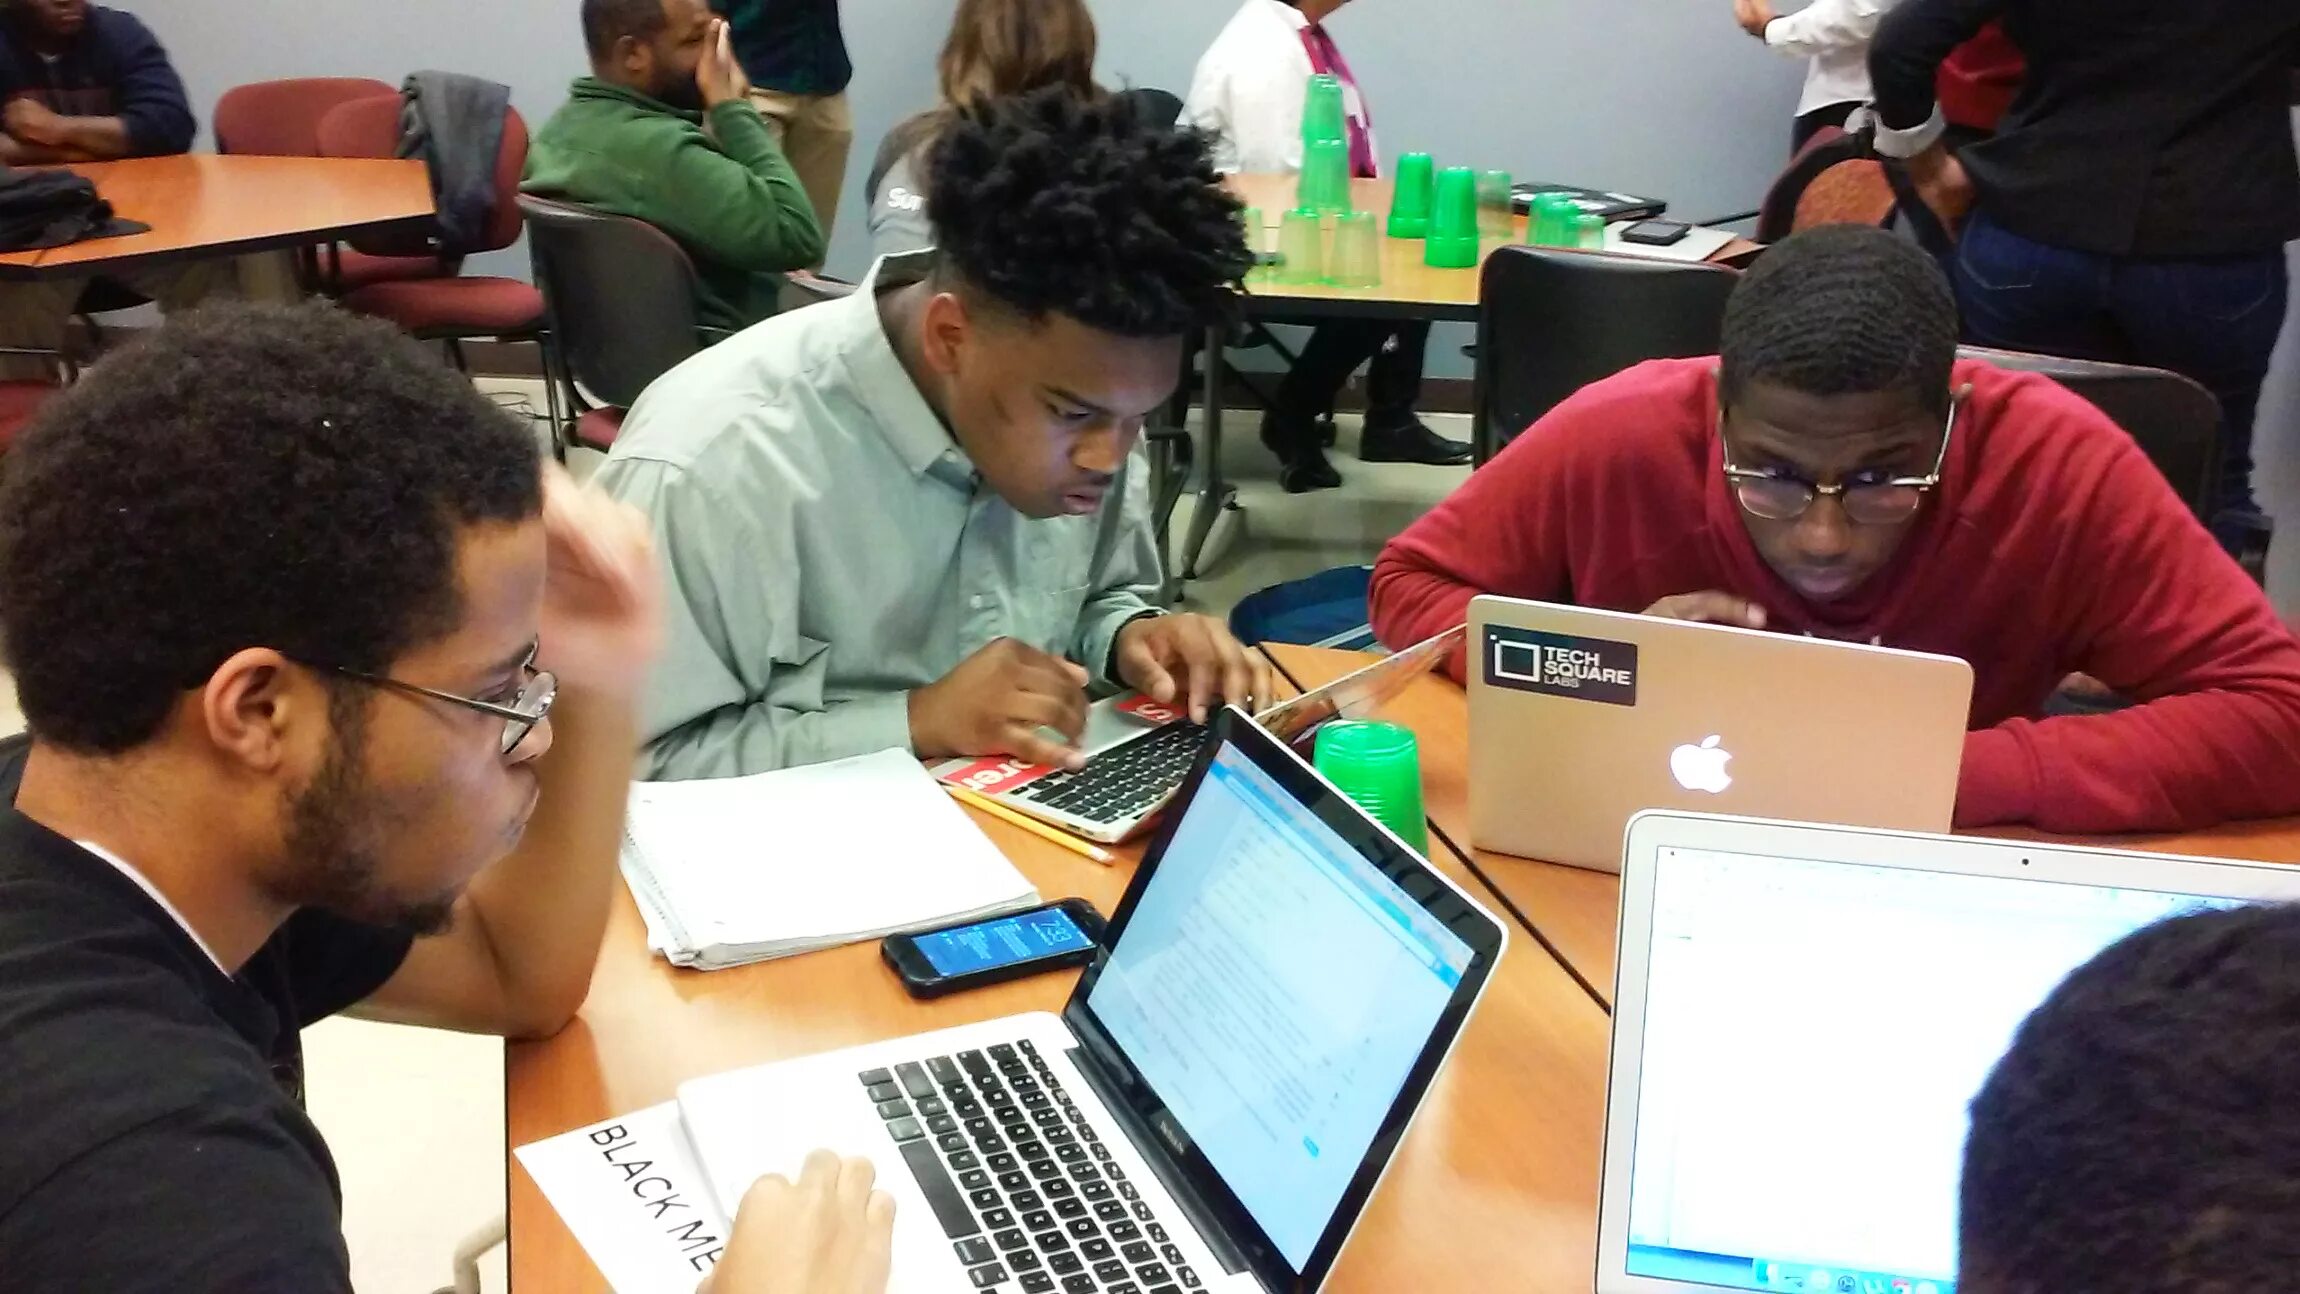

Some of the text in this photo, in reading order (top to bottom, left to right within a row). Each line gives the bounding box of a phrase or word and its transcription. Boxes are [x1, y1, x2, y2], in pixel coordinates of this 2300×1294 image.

[1543, 646, 1600, 667] TECH
[1543, 674, 1580, 688] LABS
[1544, 661, 1633, 686] SQUARE
[588, 1124, 691, 1220] BLACK
